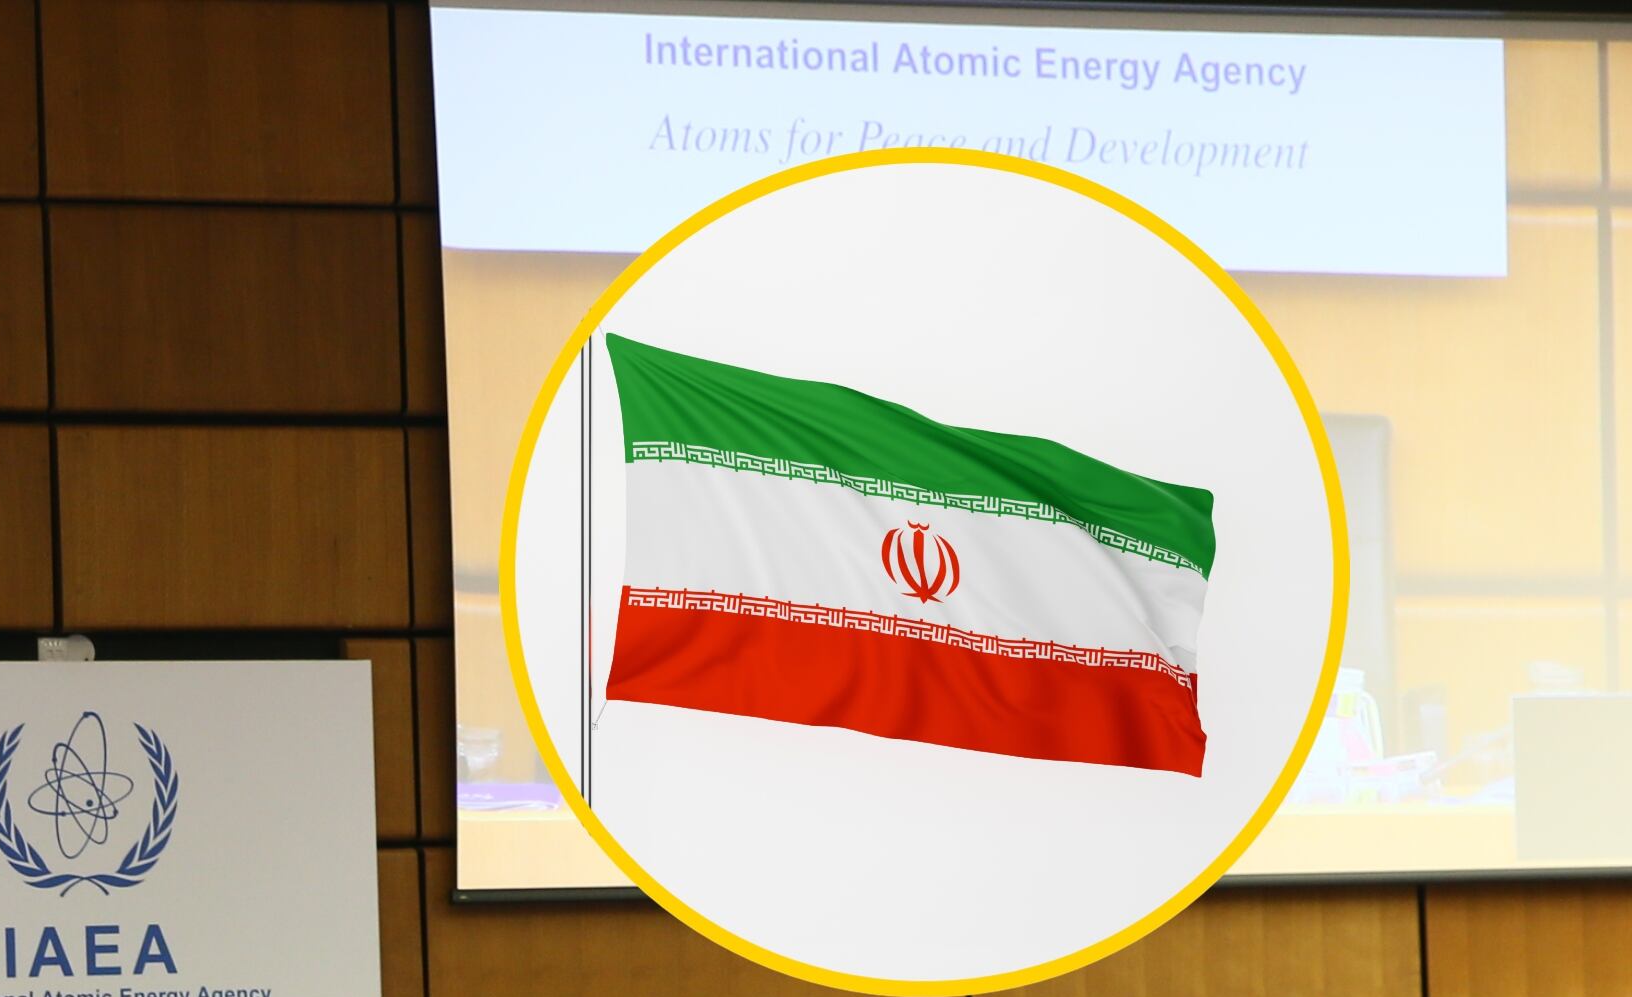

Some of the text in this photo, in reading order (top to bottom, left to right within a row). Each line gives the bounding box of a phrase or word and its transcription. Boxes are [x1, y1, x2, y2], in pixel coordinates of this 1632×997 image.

[644, 32, 1307, 96] International Atomic Energy Agency
[648, 113, 772, 154] Atoms
[779, 117, 843, 164] for
[1066, 125, 1310, 178] Development
[4, 923, 179, 979] IAEA
